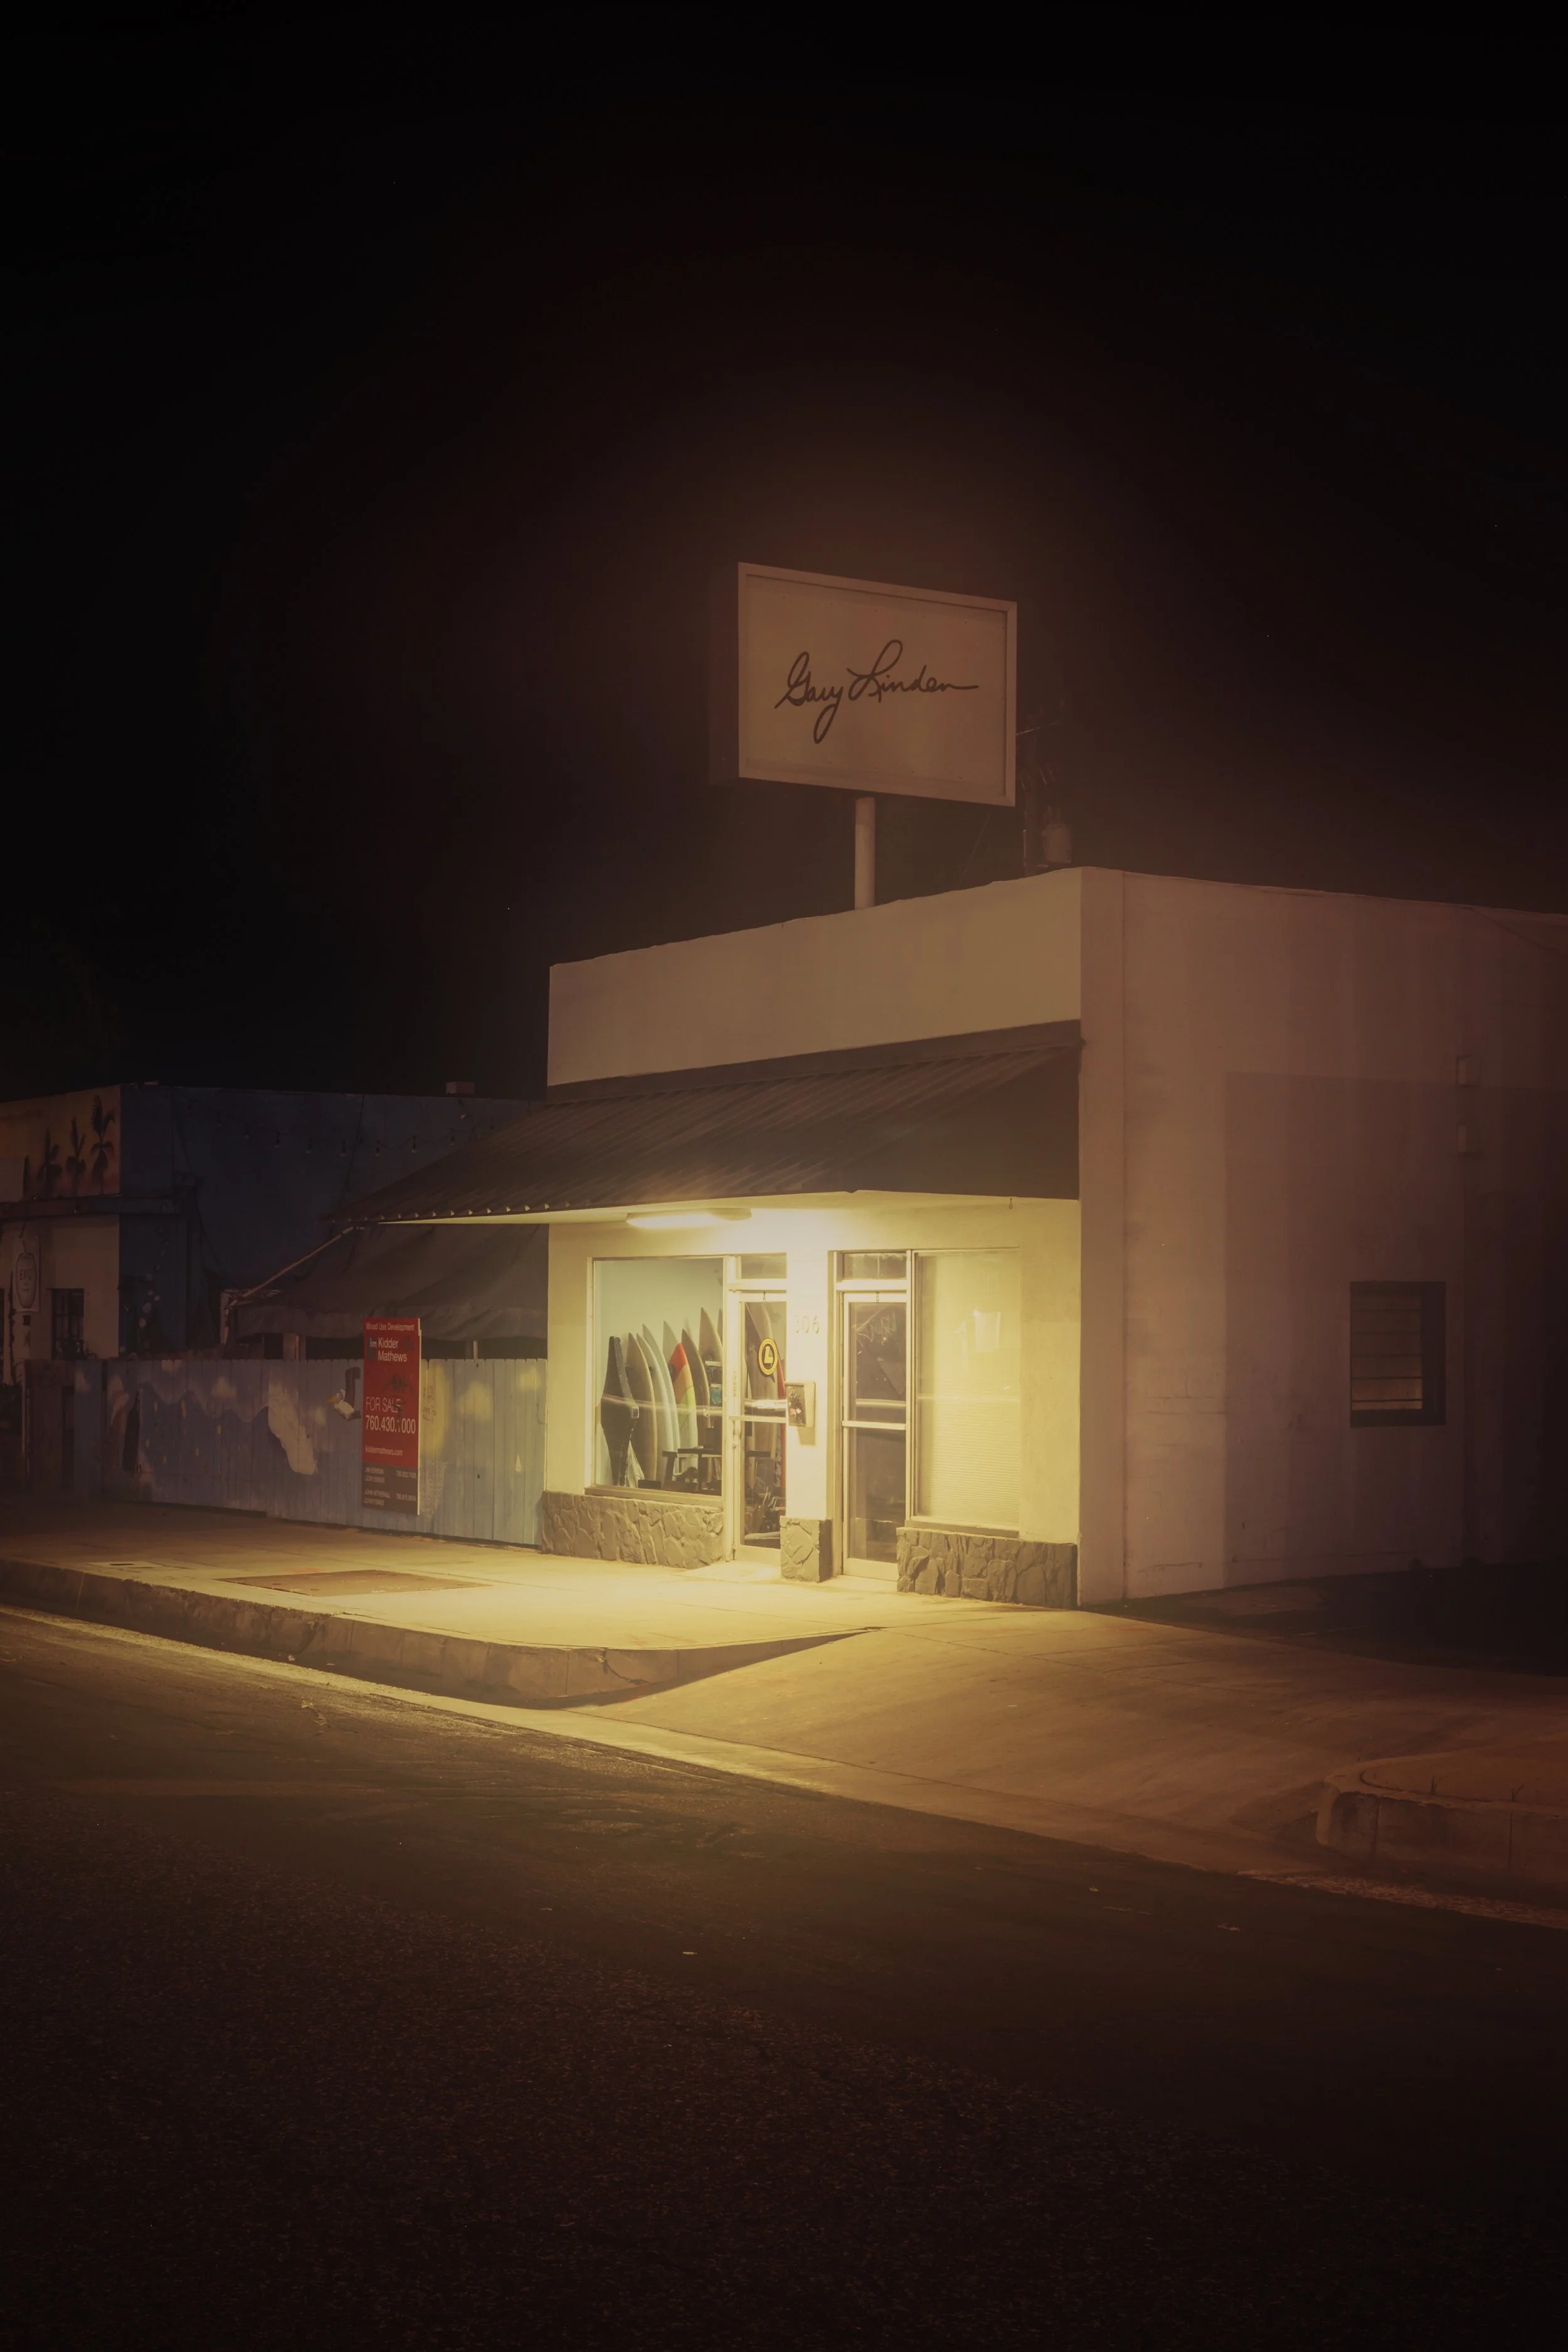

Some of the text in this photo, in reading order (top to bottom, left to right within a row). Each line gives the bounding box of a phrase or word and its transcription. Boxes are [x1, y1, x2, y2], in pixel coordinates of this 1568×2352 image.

[774, 638, 980, 744] Gary Linden
[366, 1322, 378, 1330] Mixed
[388, 1322, 415, 1332] Development
[378, 1337, 399, 1348] Kidder
[378, 1350, 407, 1362] Mathews
[366, 1397, 401, 1413] FOR SALE
